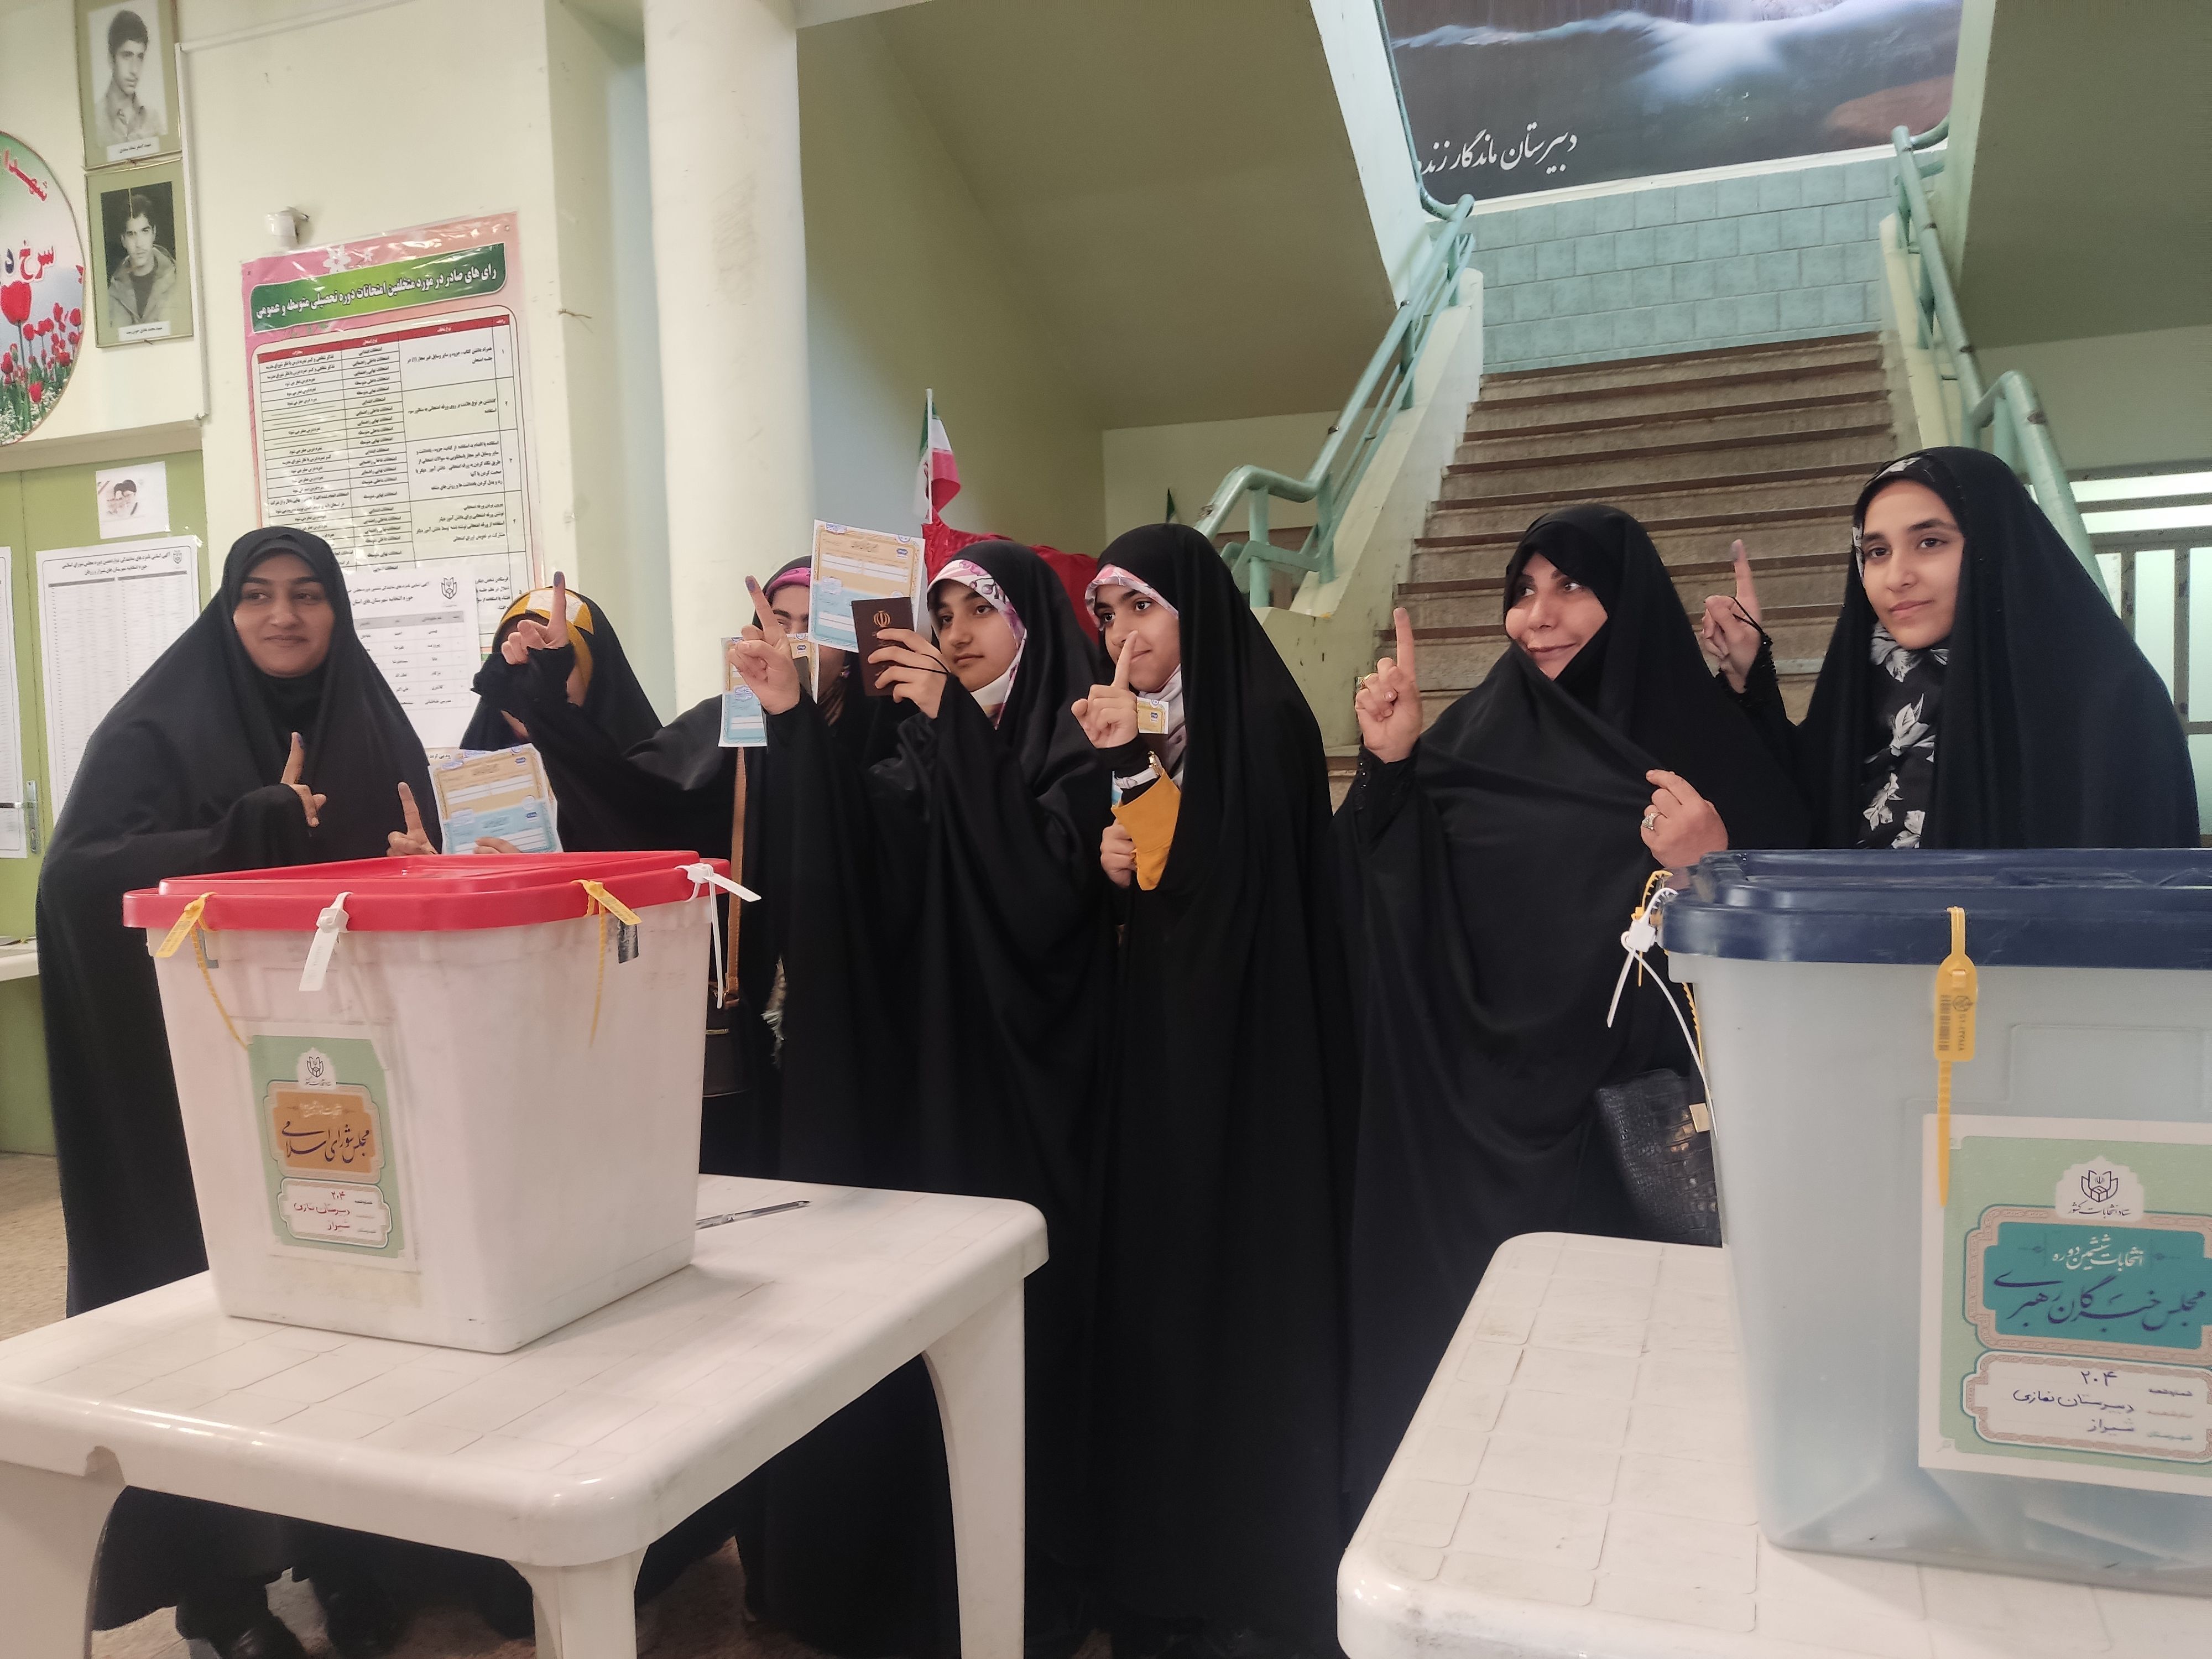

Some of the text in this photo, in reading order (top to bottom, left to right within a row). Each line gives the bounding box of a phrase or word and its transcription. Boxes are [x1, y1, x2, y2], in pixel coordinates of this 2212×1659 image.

[1449, 129, 1498, 169] ماندگار
[1500, 122, 1577, 174] دبیرستان
[19, 239, 55, 280] سرخ
[256, 262, 497, 319] رای های صادر در مورد متخلفین امتحانات دوره تحصیلی متوسطه و عمومی
[282, 1121, 369, 1164] مجلس شورای اسلامی
[331, 1191, 346, 1199] ۲۰۴
[2067, 1200, 2088, 1214] کشور
[316, 1203, 350, 1217] دبیرستان
[2079, 1204, 2119, 1219] انتخابات
[328, 1219, 349, 1232] شیراز
[2052, 1234, 2145, 1271] انتخابات ششمین دوره
[1994, 1270, 2207, 1333] مجلس خبرگان رهبری
[2080, 1371, 2117, 1386] ۲۰۴
[2013, 1389, 2135, 1414] دبیرستان نمازی
[2086, 1418, 2134, 1436] شیراز
